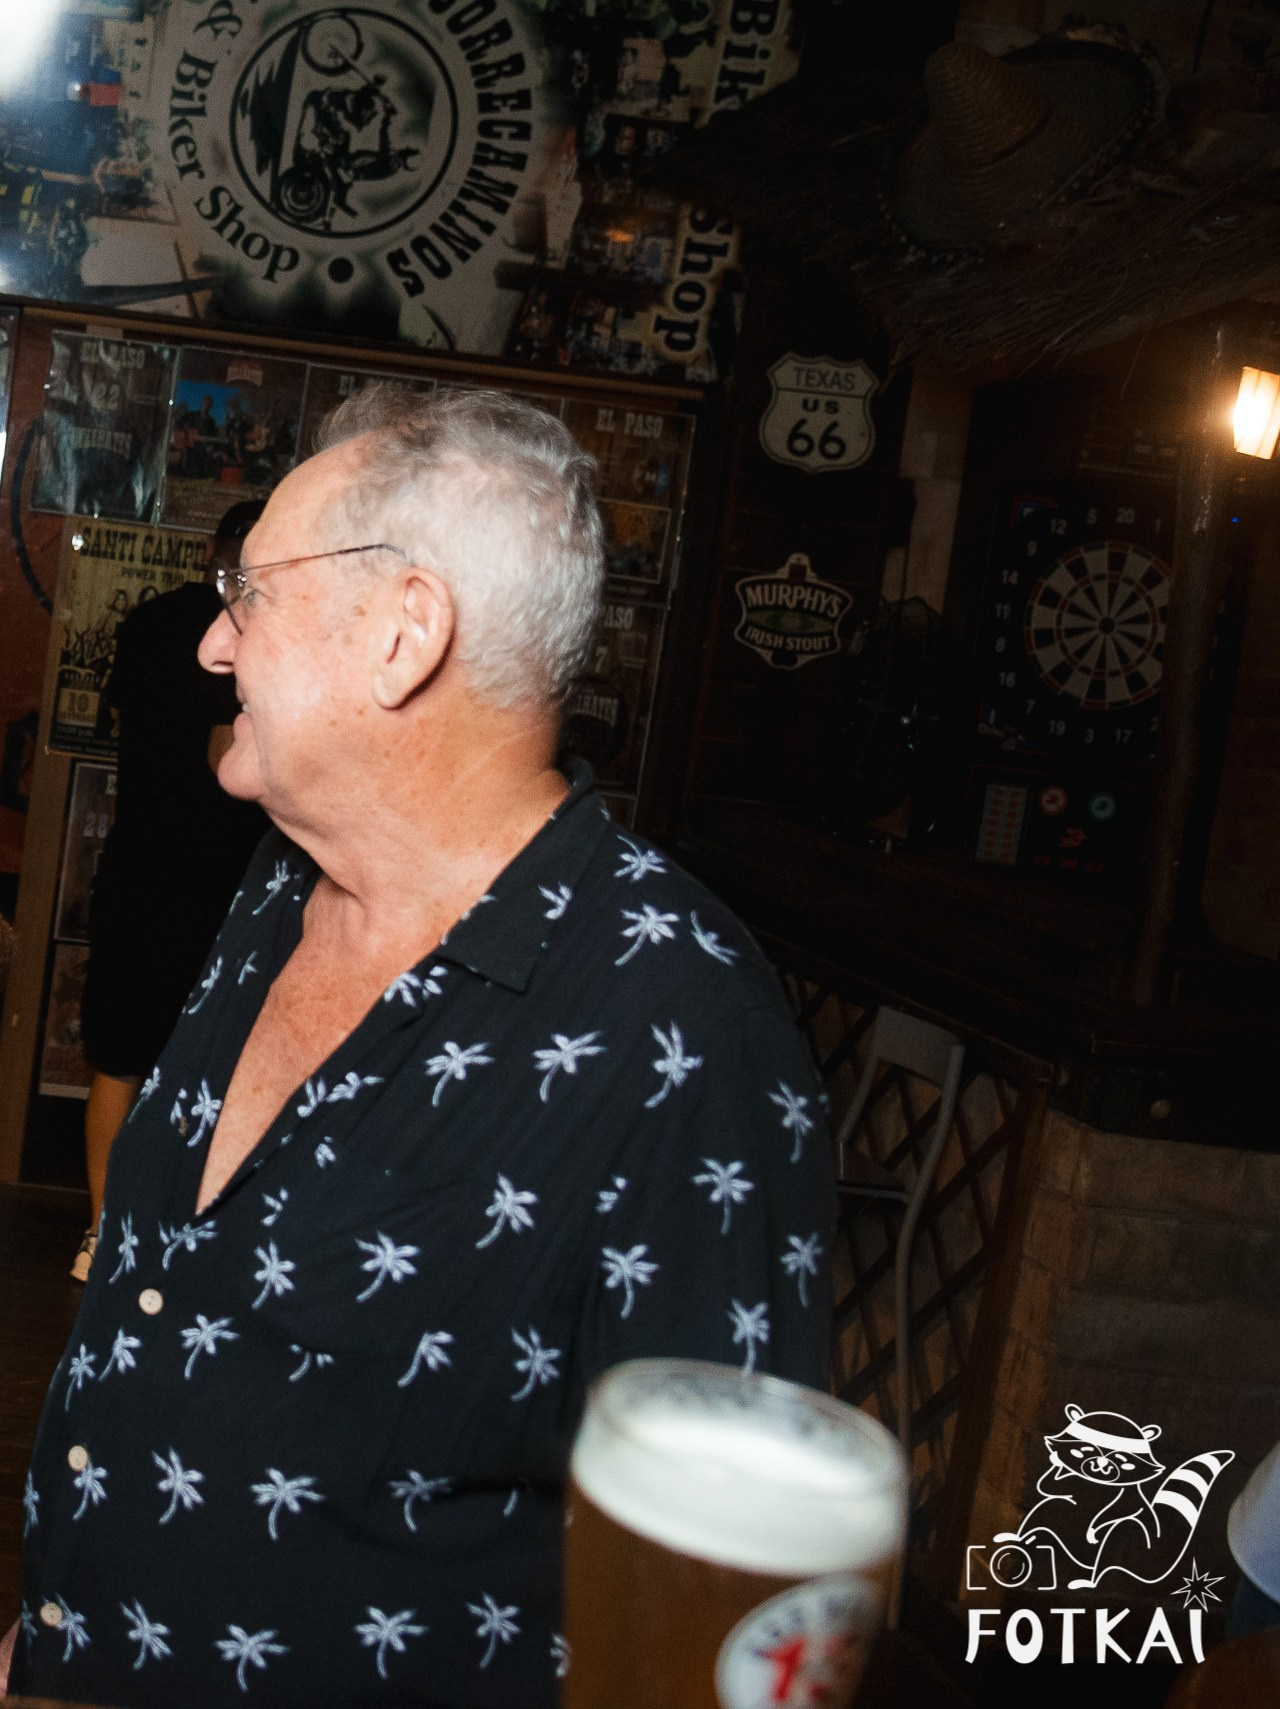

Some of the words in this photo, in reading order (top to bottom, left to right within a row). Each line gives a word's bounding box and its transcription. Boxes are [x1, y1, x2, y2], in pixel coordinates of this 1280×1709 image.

[714, 0, 779, 104] Bik
[168, 48, 218, 181] Biker
[194, 185, 301, 284] Shop
[654, 203, 733, 352] Shop
[793, 366, 856, 393] TEXAS
[802, 398, 839, 415] US
[596, 408, 617, 434] EL
[623, 411, 664, 440] PASO
[786, 418, 846, 460] 66
[1116, 506, 1136, 525] 20
[1050, 517, 1068, 536] 12
[80, 527, 137, 562] SANTI
[1027, 540, 1038, 557] 9
[1001, 568, 1020, 587] 14
[995, 602, 1011, 620] 11
[744, 626, 785, 650] IRISH
[785, 635, 831, 652] STOUT
[995, 636, 1006, 653] 8
[999, 670, 1017, 688] 16
[1048, 719, 1068, 736] 19
[1084, 728, 1095, 744] 3
[1115, 728, 1133, 745] 17
